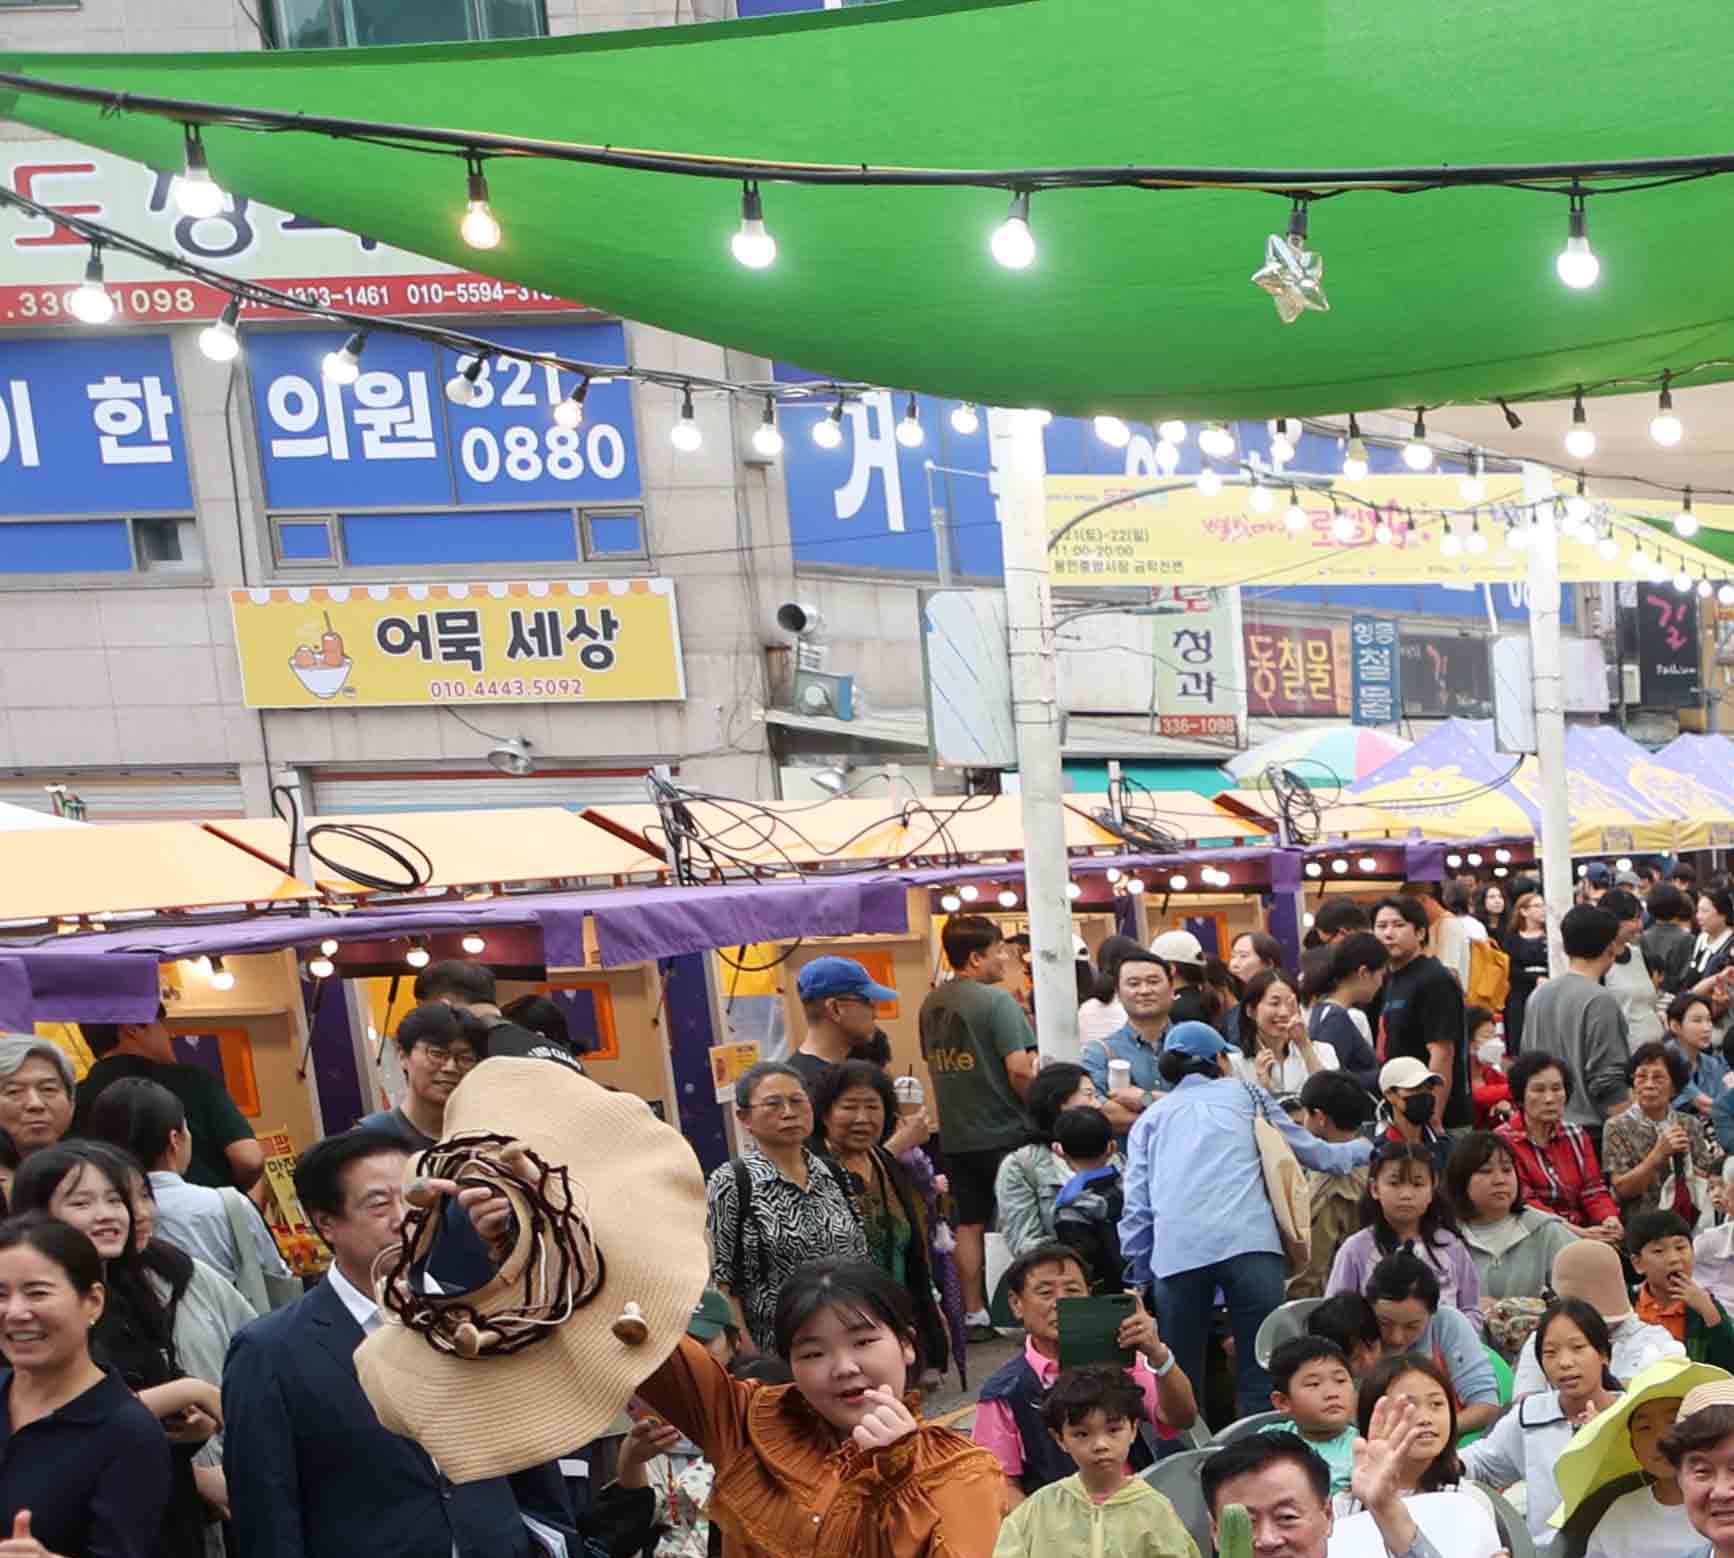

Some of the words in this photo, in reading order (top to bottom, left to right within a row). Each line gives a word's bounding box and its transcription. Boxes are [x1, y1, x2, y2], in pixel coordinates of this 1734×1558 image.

[461, 424, 626, 483] 0880
[376, 608, 484, 673] 어묵
[506, 608, 620, 672] 세상
[430, 678, 584, 698] 010.4443.5092
